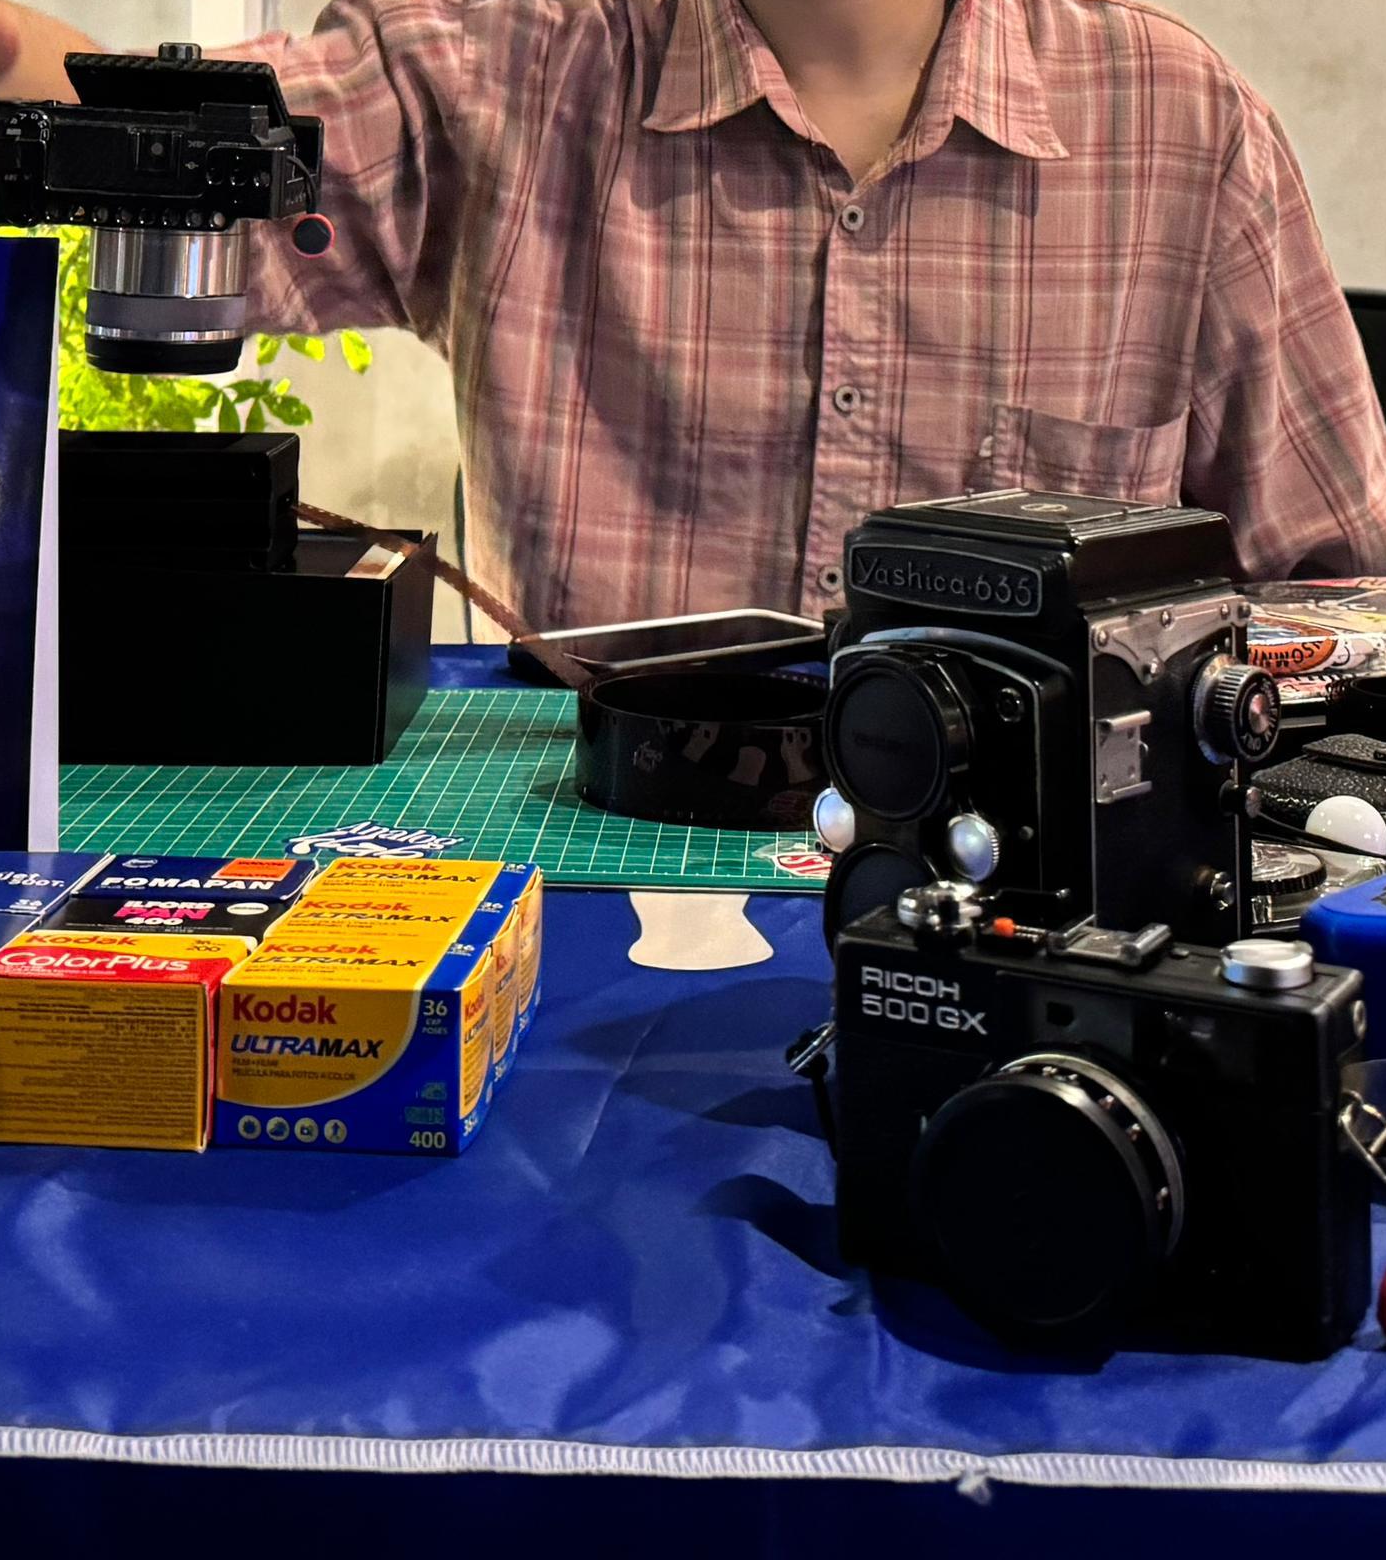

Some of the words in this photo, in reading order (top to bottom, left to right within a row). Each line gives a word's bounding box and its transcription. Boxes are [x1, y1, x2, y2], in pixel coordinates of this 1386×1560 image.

[335, 861, 442, 872] Kodak
[325, 871, 482, 883] ULTRAMAX
[100, 877, 274, 890] FOMAPAN
[124, 900, 215, 909] ILFORD
[301, 901, 415, 912] Kodak
[114, 907, 212, 920] PAN
[290, 911, 458, 923] ULTRAMAX
[124, 917, 183, 926] 400
[25, 934, 138, 946] Kodak
[263, 943, 379, 955] Kodak
[0, 951, 191, 972] ColorPlus
[250, 955, 427, 967] ULTRAMAX
[861, 966, 960, 1001] RICOH
[232, 993, 337, 1025] Kodak
[422, 999, 448, 1016] 36
[230, 1034, 383, 1059] ULTRAMAX
[409, 1131, 446, 1149] 400
